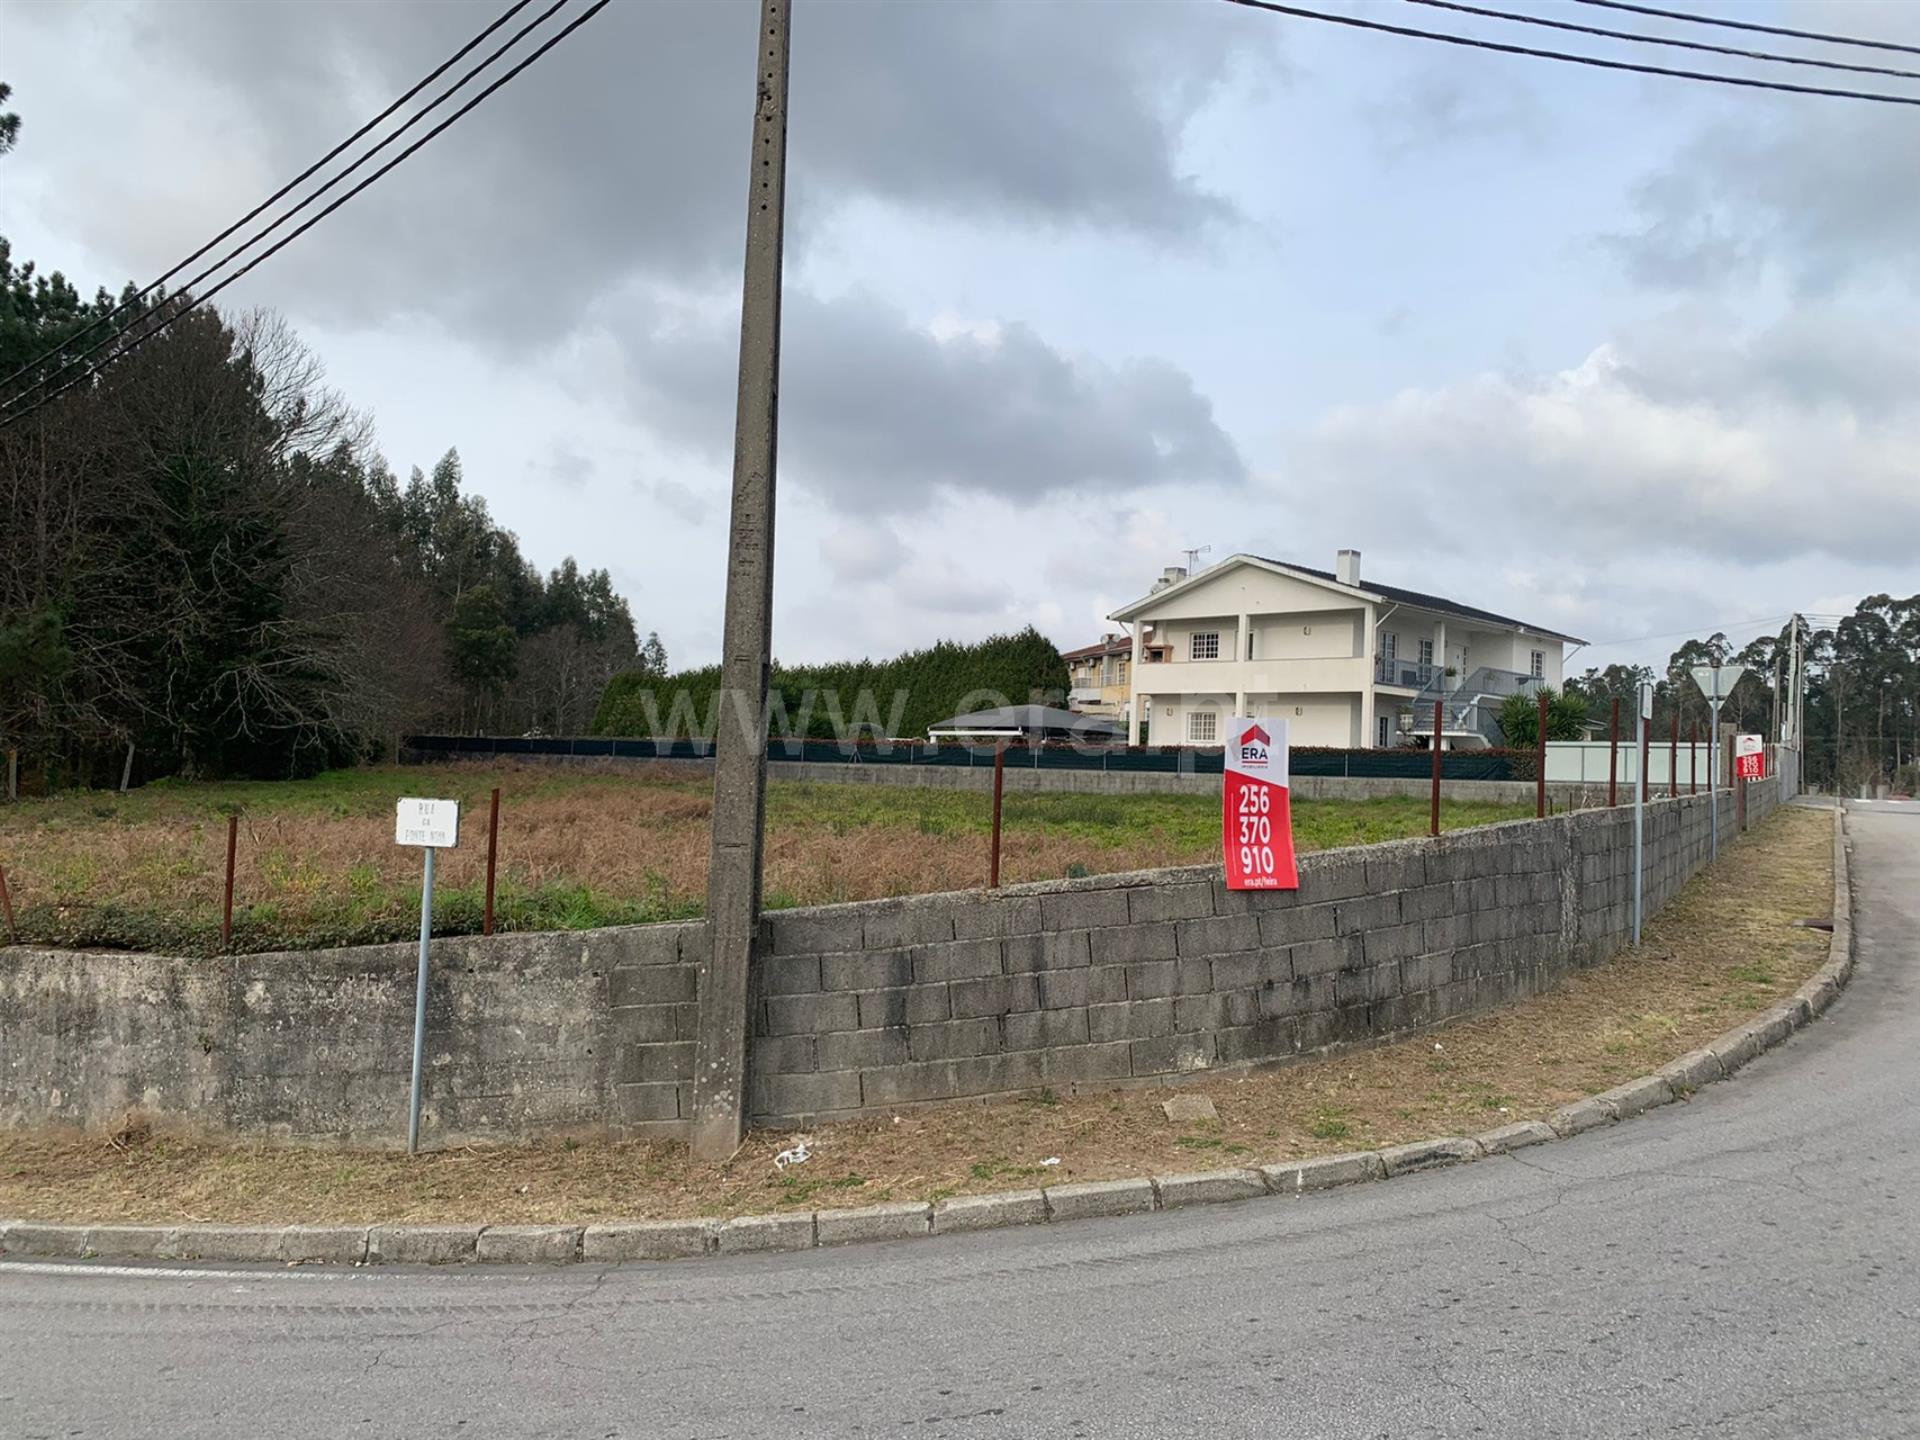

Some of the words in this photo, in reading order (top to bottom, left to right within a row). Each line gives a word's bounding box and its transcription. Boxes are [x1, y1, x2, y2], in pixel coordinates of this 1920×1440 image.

[1241, 747, 1268, 760] ERA
[1239, 785, 1269, 813] 256
[1239, 816, 1270, 844] 370
[1241, 846, 1273, 874] 910
